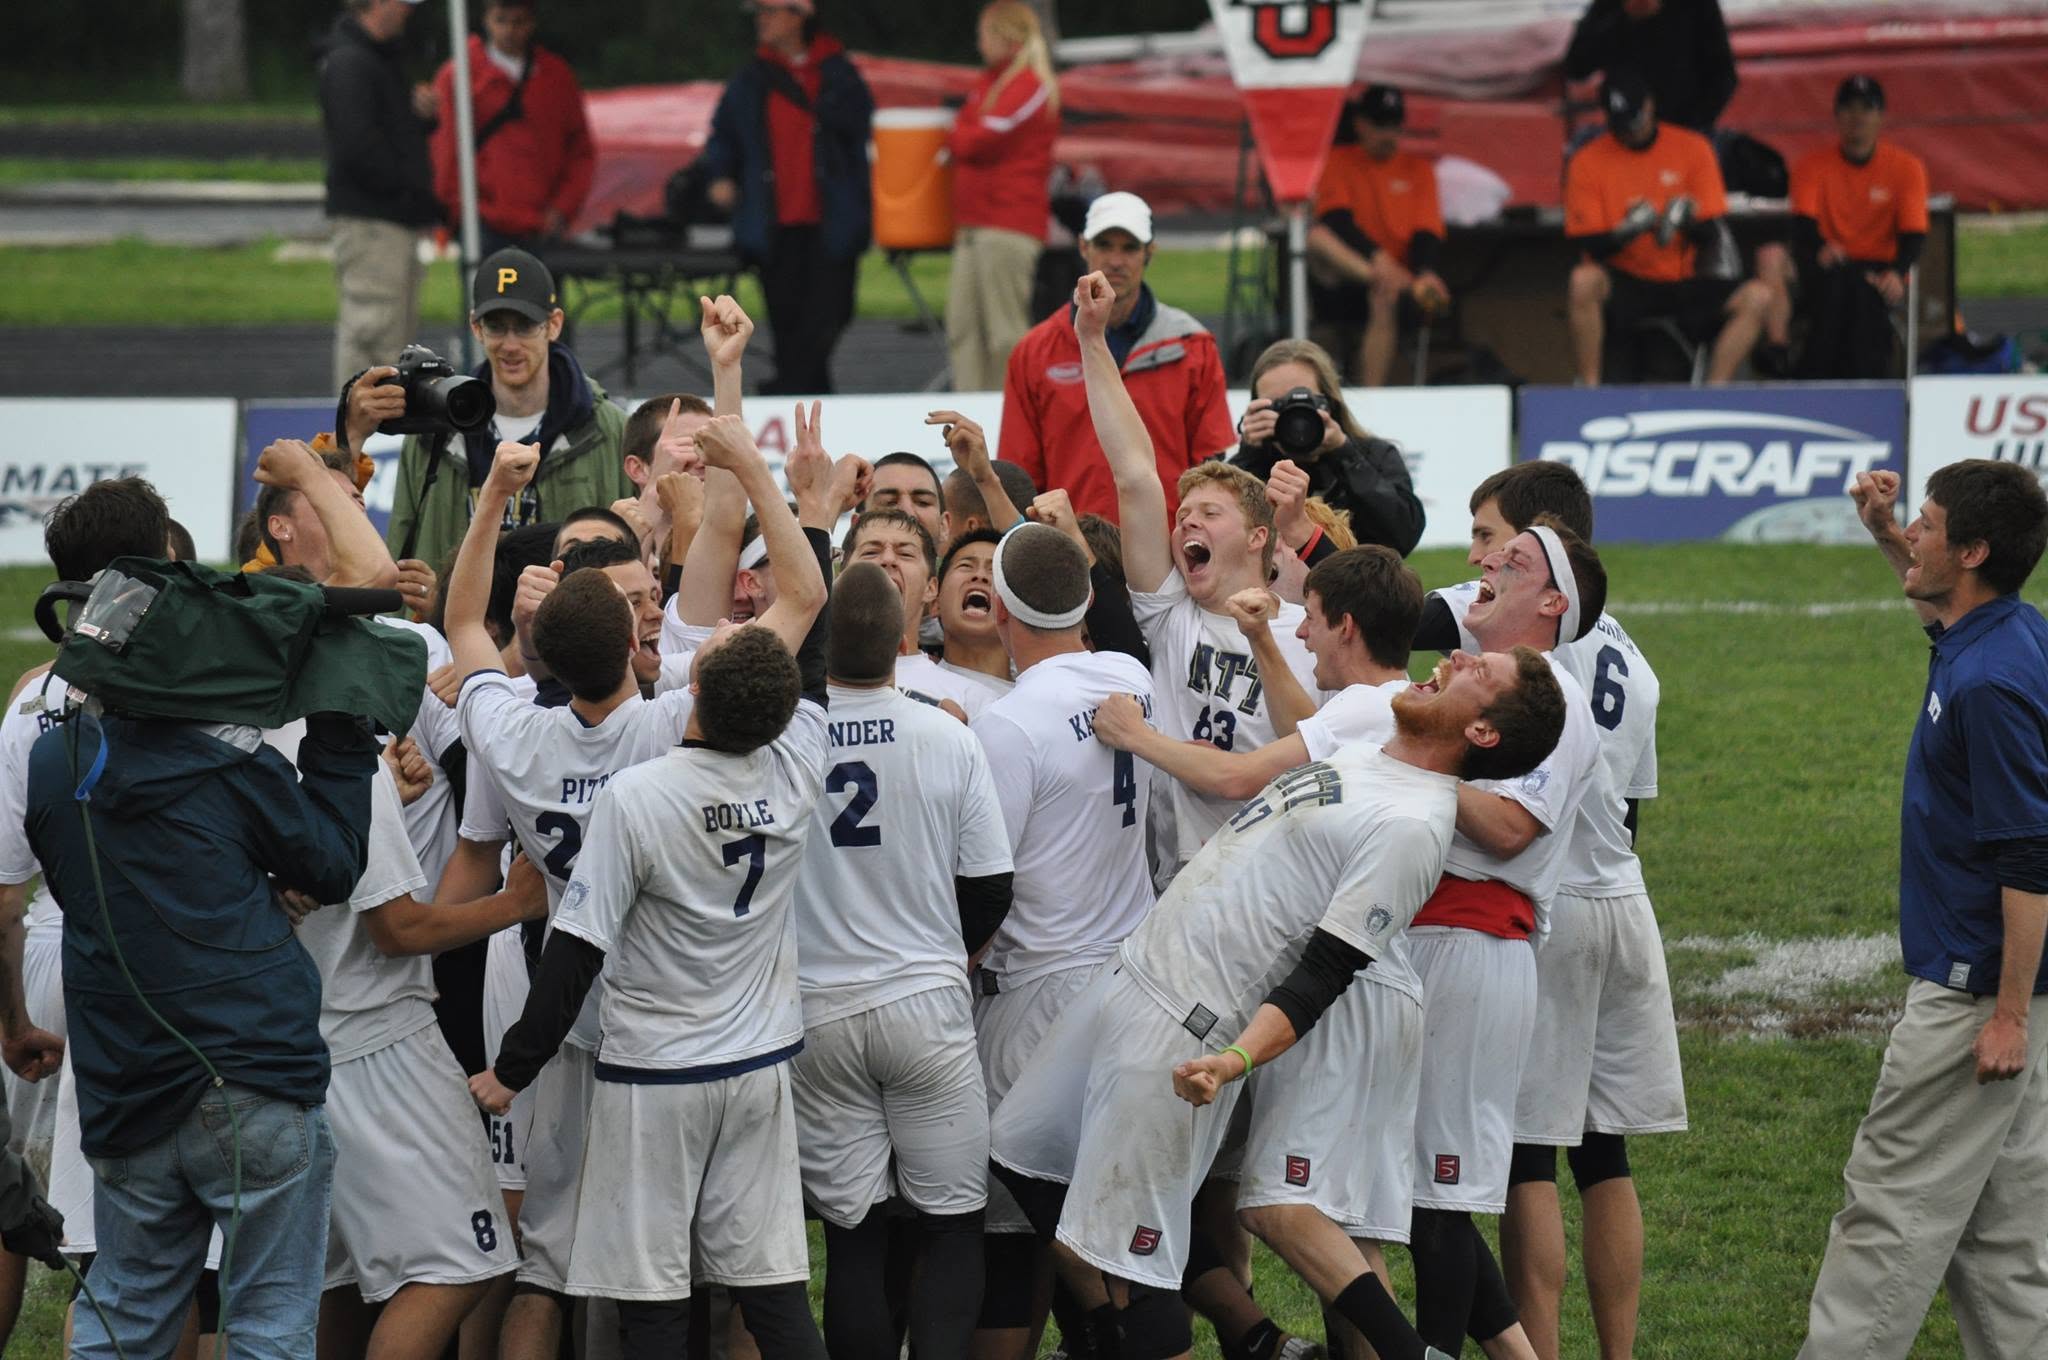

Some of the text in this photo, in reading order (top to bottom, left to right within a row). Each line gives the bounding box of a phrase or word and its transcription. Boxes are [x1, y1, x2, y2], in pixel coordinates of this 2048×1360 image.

[497, 268, 518, 294] P
[1540, 438, 1891, 497] DISCRAFT
[1590, 644, 1629, 731] 6
[702, 799, 775, 833] BOYLE
[825, 761, 882, 848] 2
[722, 834, 766, 918] 7
[492, 1121, 515, 1164] 51
[471, 1208, 497, 1253] 8
